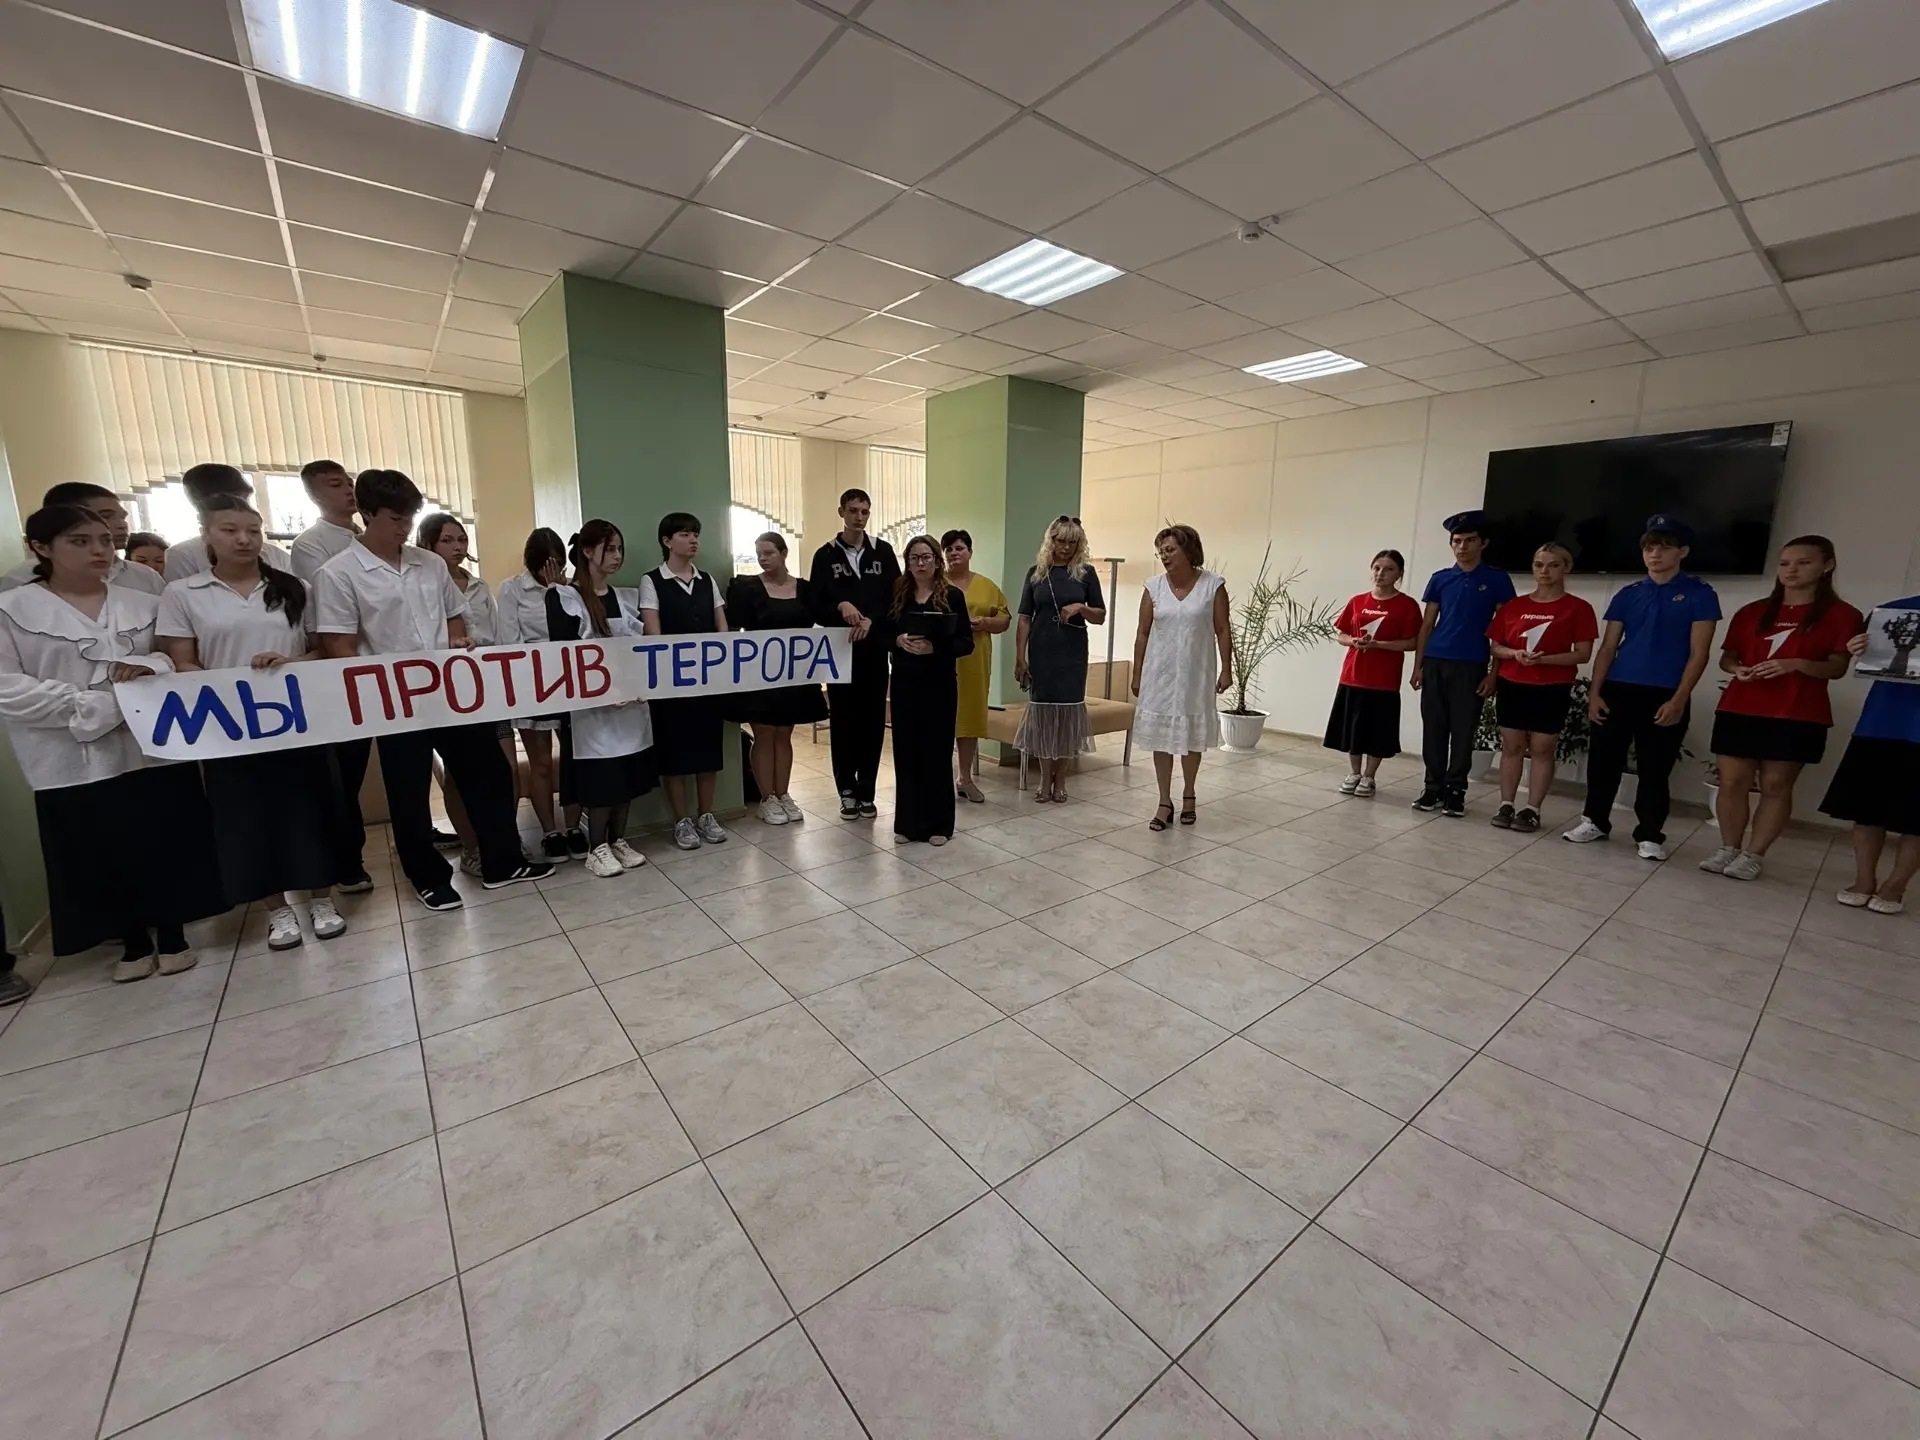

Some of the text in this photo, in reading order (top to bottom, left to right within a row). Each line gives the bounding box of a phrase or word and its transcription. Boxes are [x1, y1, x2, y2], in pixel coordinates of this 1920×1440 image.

[151, 634, 840, 747] МЫ ПРОТИВ ТЕРРОРА
